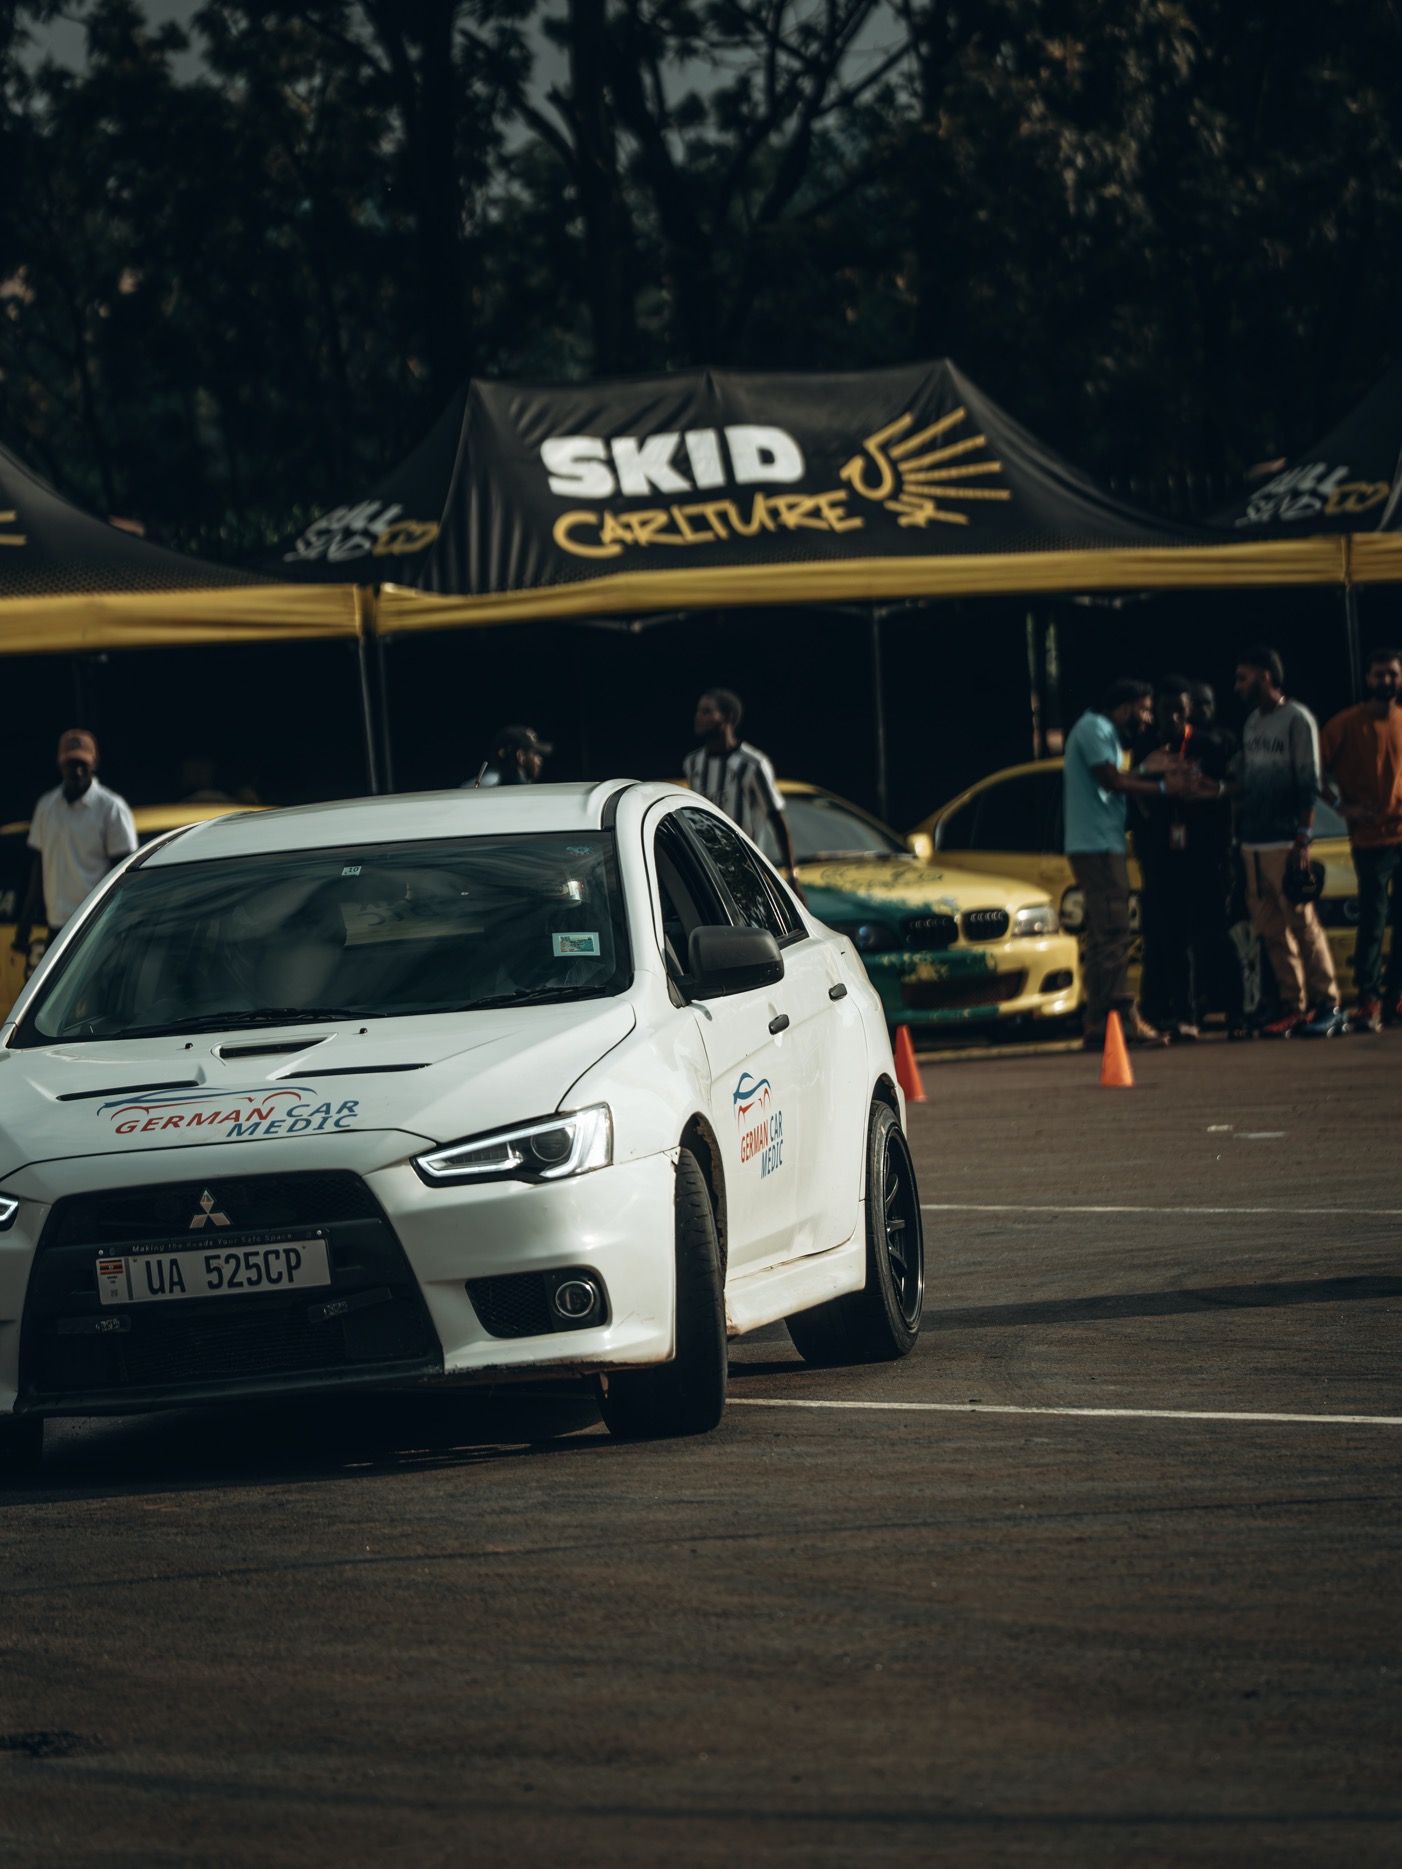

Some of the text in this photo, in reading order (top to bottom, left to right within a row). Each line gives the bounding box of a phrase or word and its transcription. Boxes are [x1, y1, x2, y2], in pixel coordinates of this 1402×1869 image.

[540, 424, 805, 498] SKID
[115, 1100, 360, 1134] GERMAN CAR
[225, 1114, 358, 1138] MEDIC
[741, 1110, 783, 1163] GERMAN CAR
[760, 1139, 783, 1179] MEDIC
[132, 1243, 165, 1253] Making
[168, 1240, 183, 1249] the
[217, 1237, 237, 1246] Your
[241, 1235, 261, 1244] Safe
[265, 1233, 292, 1242] Space
[145, 1247, 302, 1295] UA 525CP
